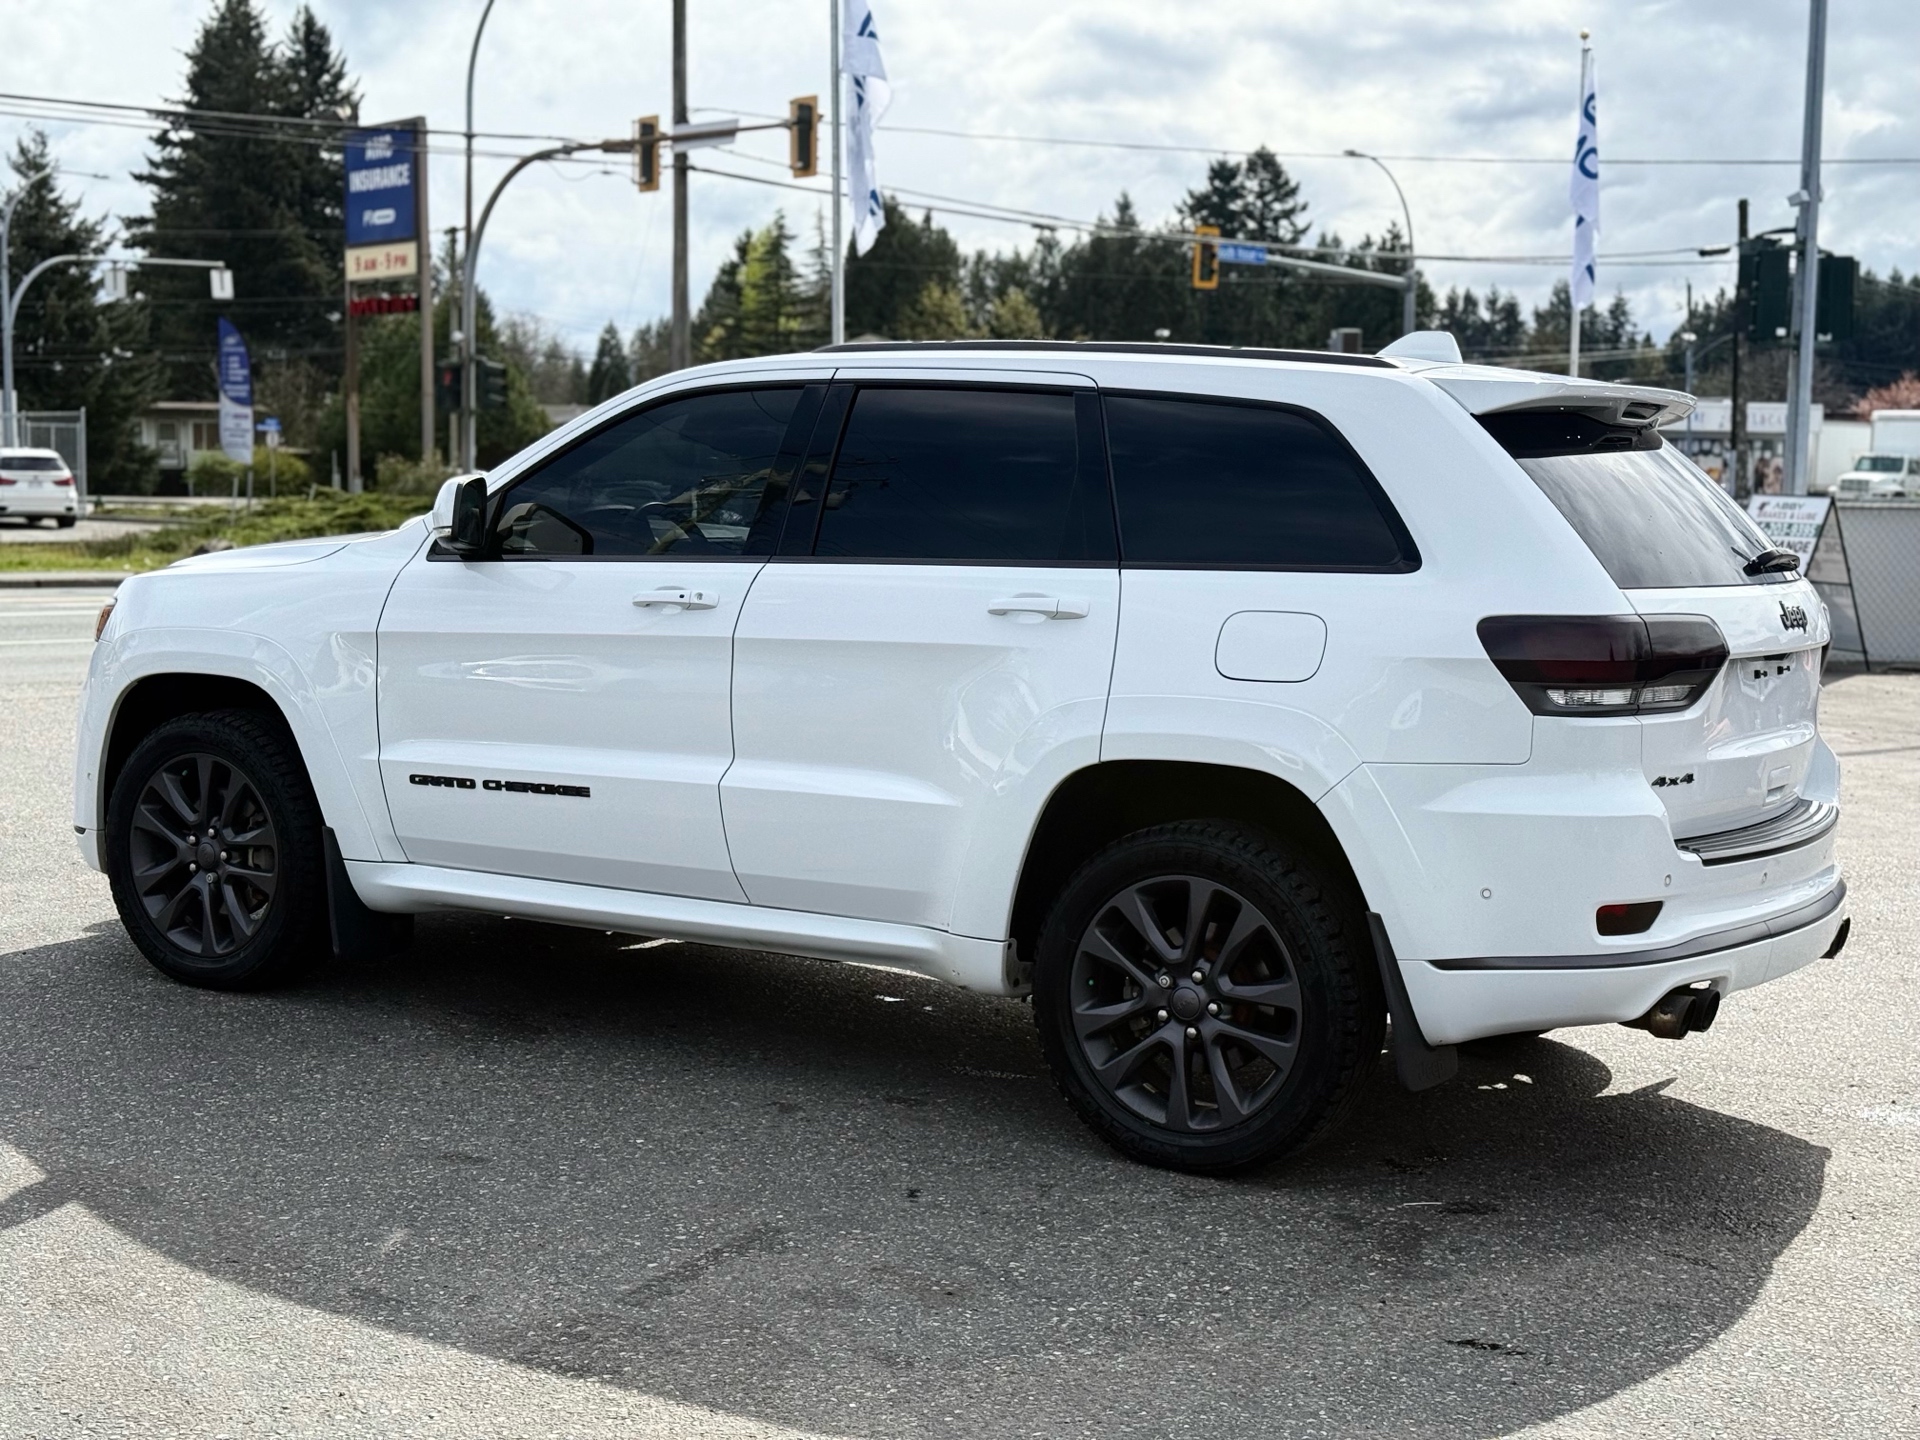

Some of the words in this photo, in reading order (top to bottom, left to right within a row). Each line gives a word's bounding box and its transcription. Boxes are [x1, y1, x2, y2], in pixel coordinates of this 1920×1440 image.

[349, 163, 410, 192] INSURANCE
[1757, 510, 1787, 519] BRAKES
[1796, 512, 1817, 521] LUBE
[1773, 502, 1806, 510] ABBY
[1779, 600, 1808, 634] Jeep
[409, 773, 476, 790] GRAND
[482, 779, 591, 798] CHEROKEE
[1651, 773, 1695, 788] 4x4
